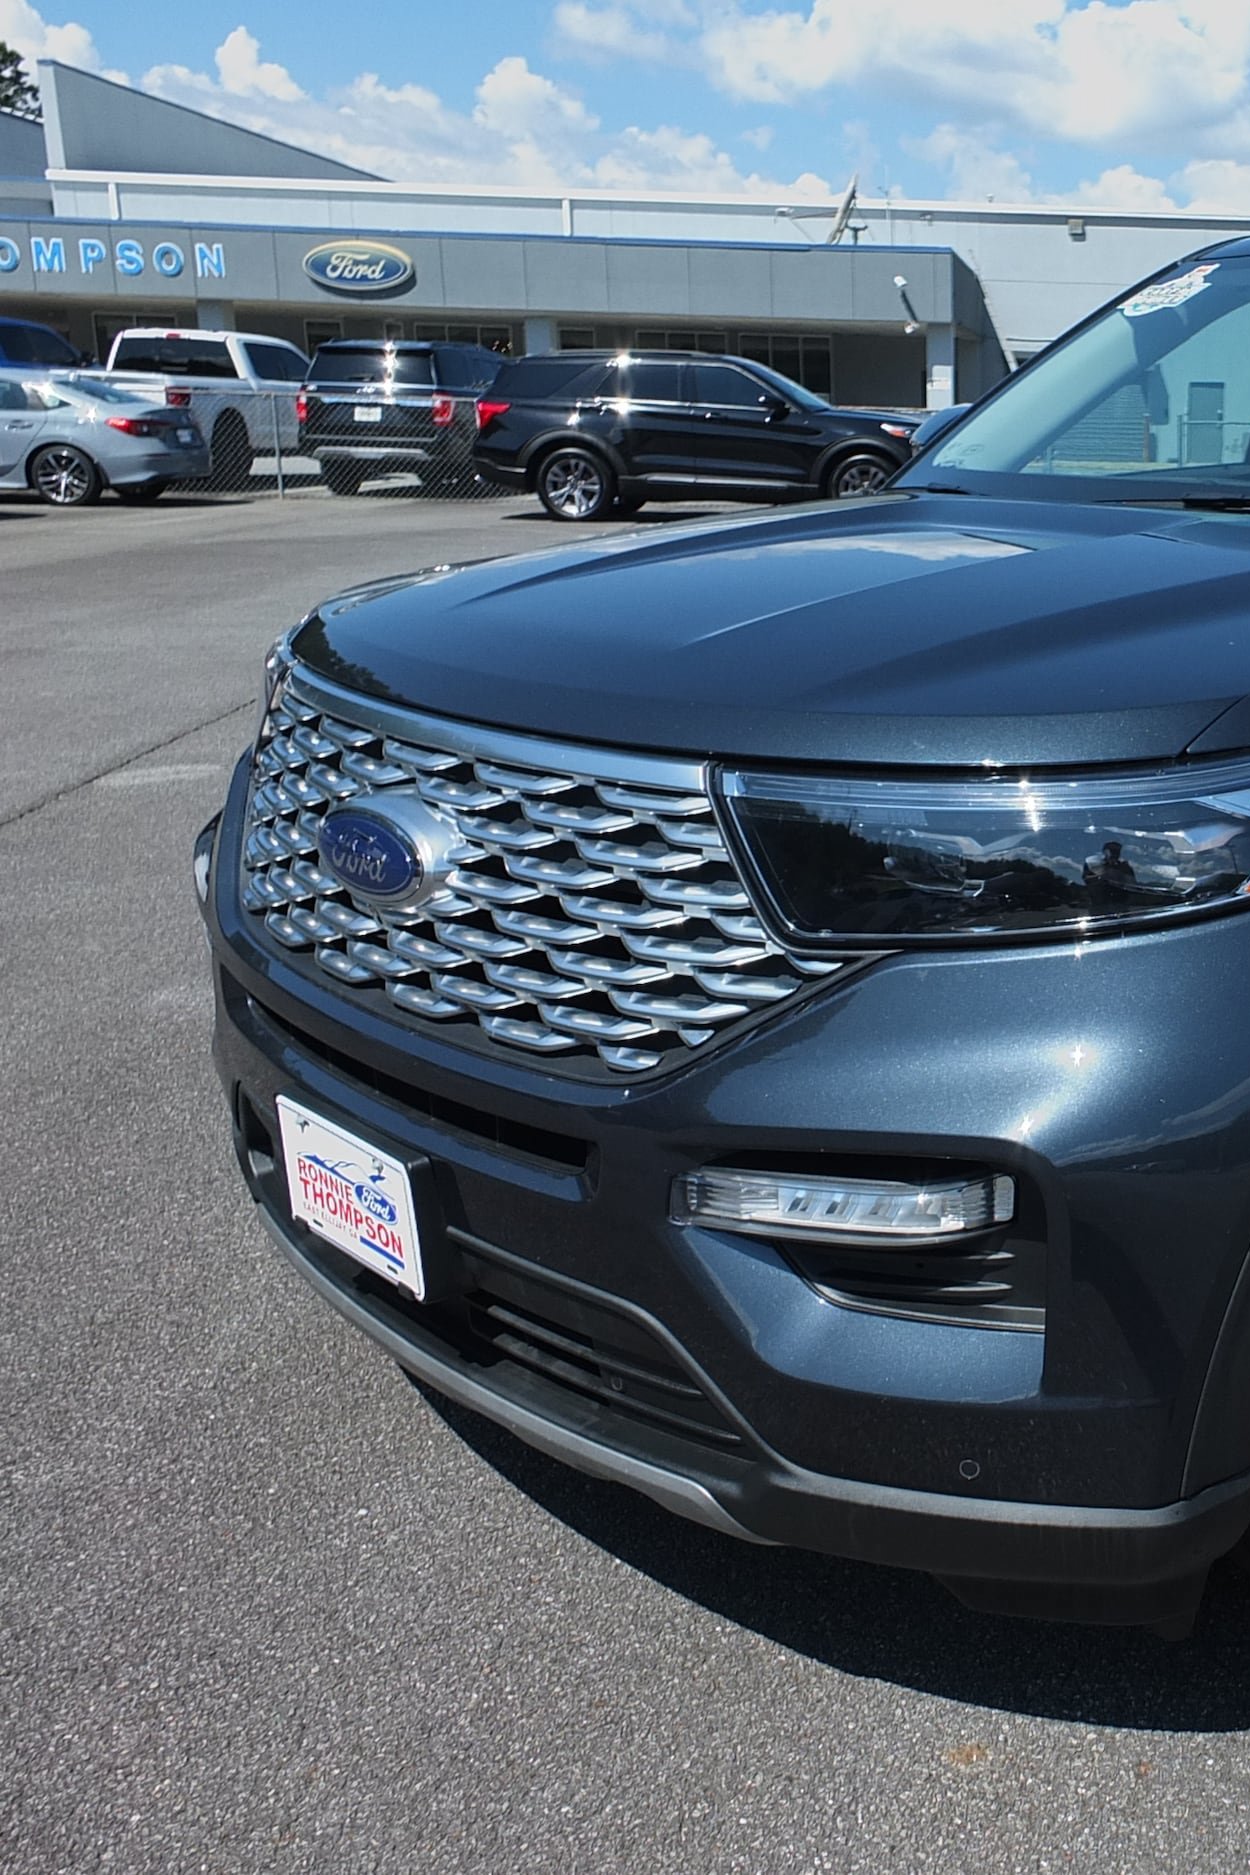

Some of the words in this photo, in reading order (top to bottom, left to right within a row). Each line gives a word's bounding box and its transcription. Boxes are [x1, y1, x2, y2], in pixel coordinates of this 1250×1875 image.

[0, 236, 226, 278] OMPSON
[325, 251, 387, 281] Ford
[297, 1157, 354, 1206] RONNIE
[299, 1176, 404, 1259] THOMPSON
[361, 1186, 391, 1221] Ford
